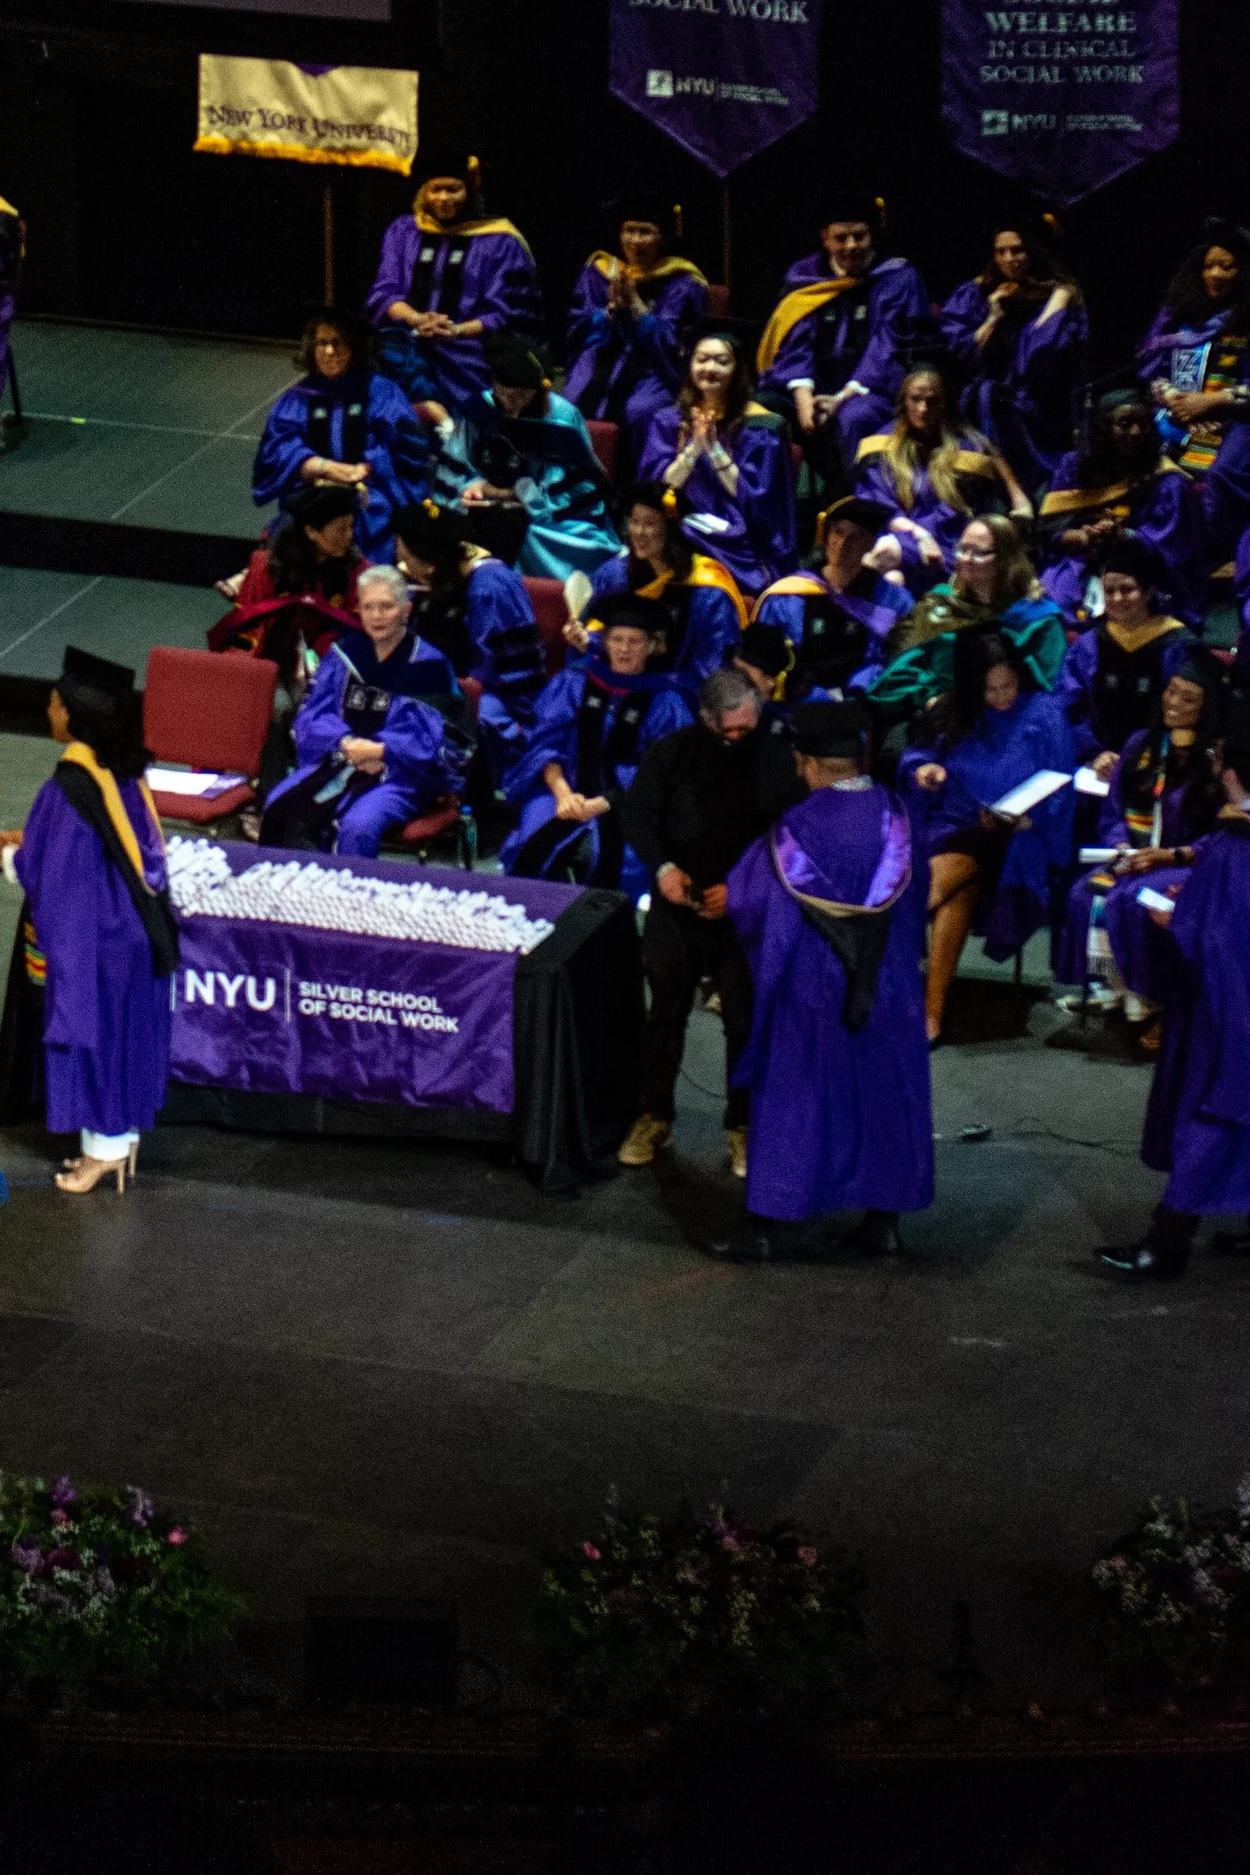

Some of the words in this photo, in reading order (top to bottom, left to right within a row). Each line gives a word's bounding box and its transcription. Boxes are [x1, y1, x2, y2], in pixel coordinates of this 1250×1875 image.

[184, 968, 277, 1012] NYU
[298, 980, 364, 1004] SILVER
[366, 988, 443, 1014] SCHOOL
[298, 999, 327, 1017] OF
[329, 1001, 398, 1026] SOCIAL
[400, 1009, 460, 1033] WORK
